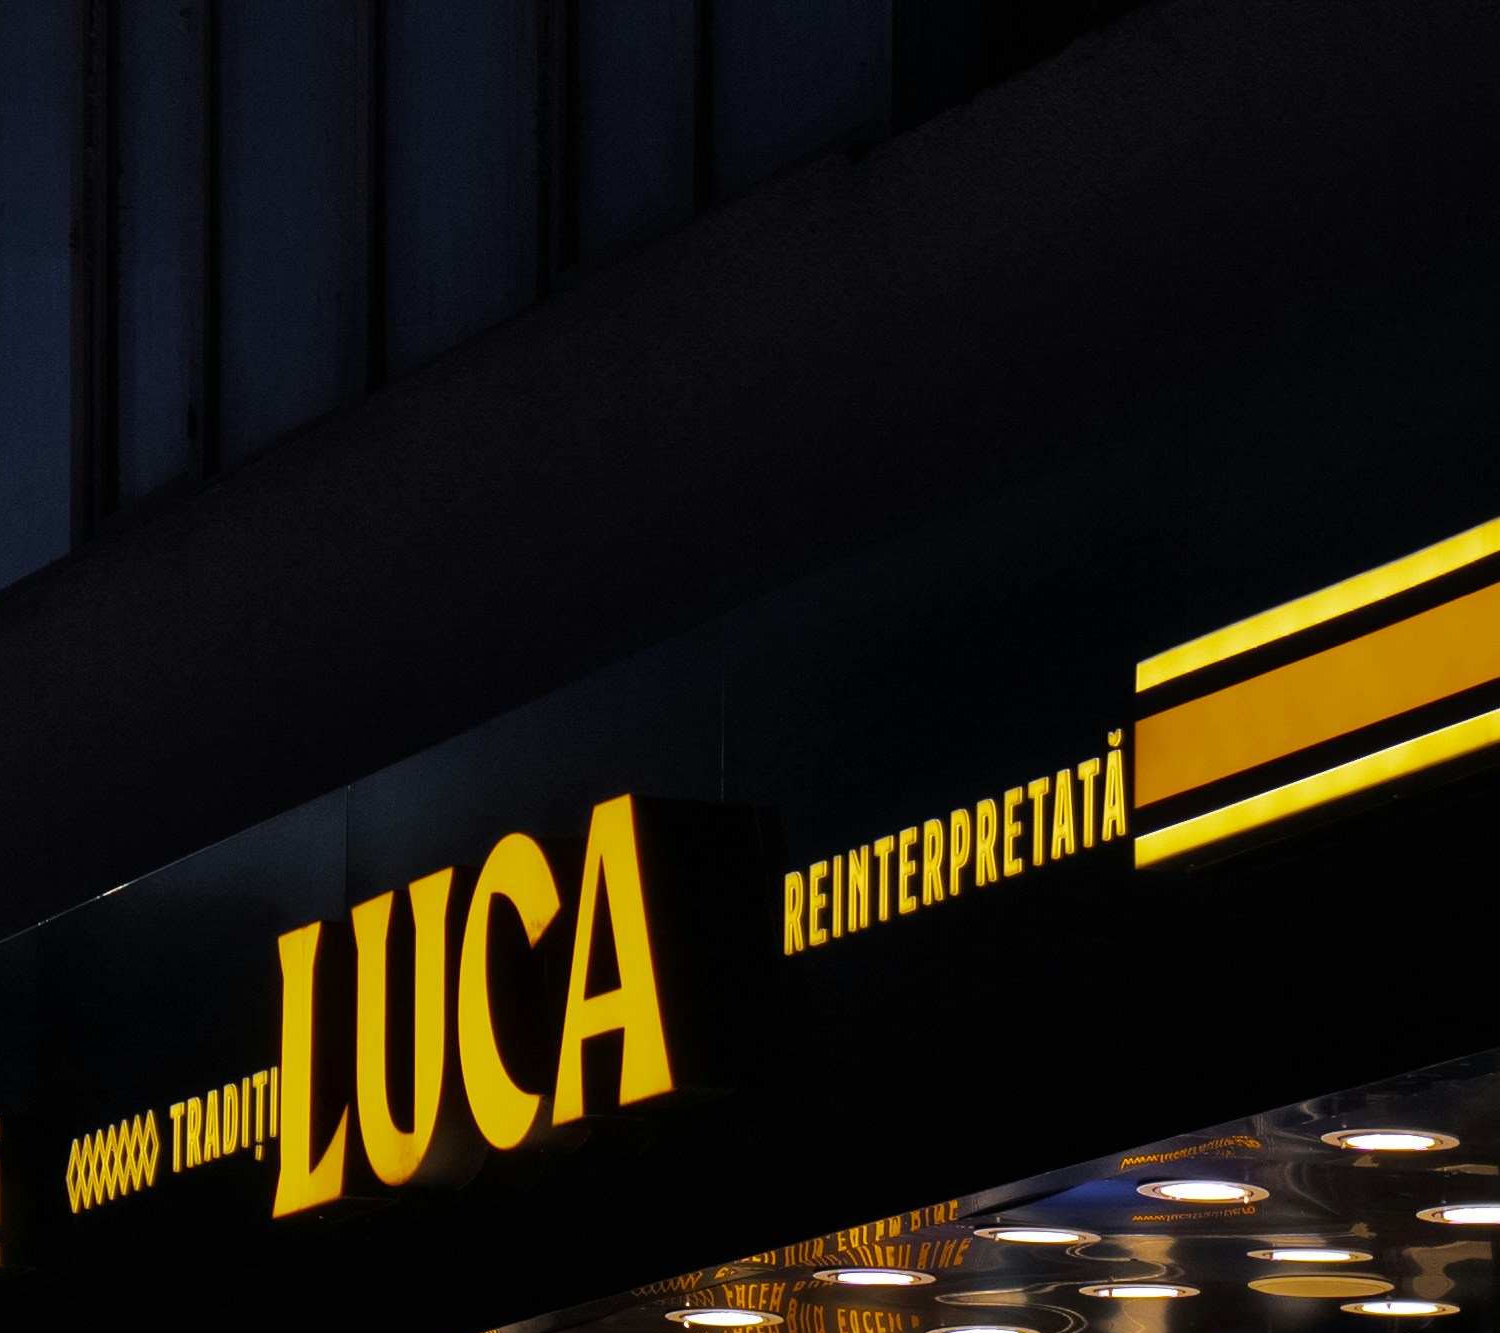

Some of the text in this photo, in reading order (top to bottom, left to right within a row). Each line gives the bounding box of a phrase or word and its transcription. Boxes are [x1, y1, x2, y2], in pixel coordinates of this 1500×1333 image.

[783, 729, 1127, 956] REINTERPRETATĂ
[170, 1066, 278, 1173] TRADIȚI
[272, 794, 674, 1218] LUCA
